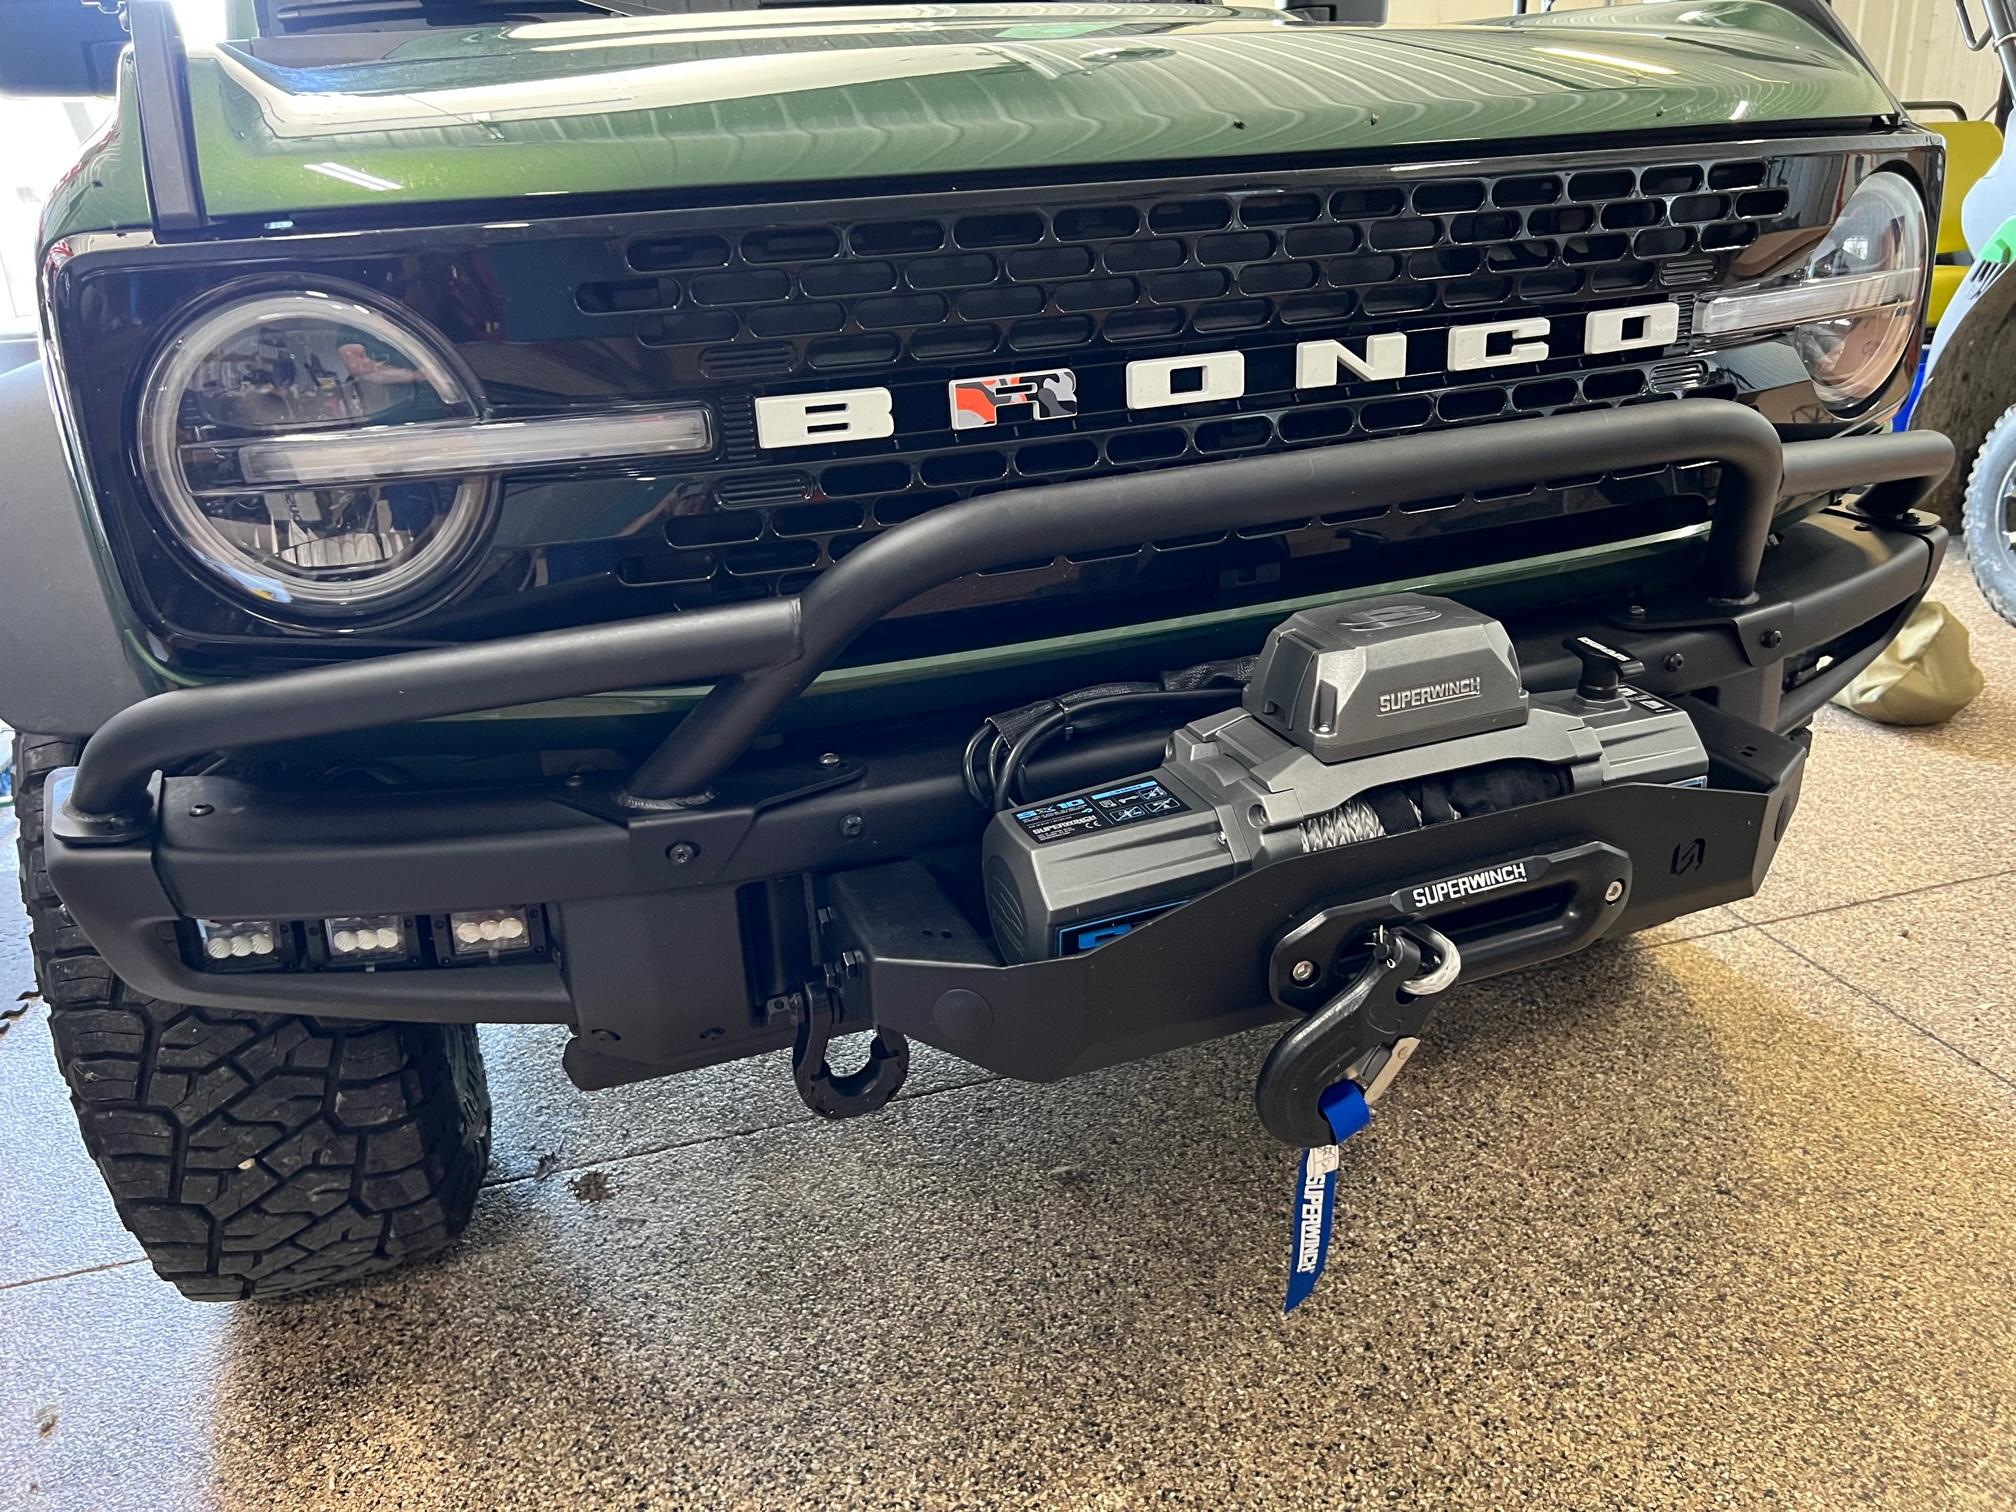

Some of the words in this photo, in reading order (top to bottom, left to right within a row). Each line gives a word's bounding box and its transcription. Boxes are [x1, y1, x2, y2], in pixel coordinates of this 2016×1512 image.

[755, 302, 1680, 449] BRONCO
[1380, 677, 1480, 712] SUPERWINCH
[1032, 814, 1098, 834] SUPERWINCH
[1412, 862, 1527, 907] SUPERWINCH
[1297, 1174, 1326, 1273] SUPERWINCH
